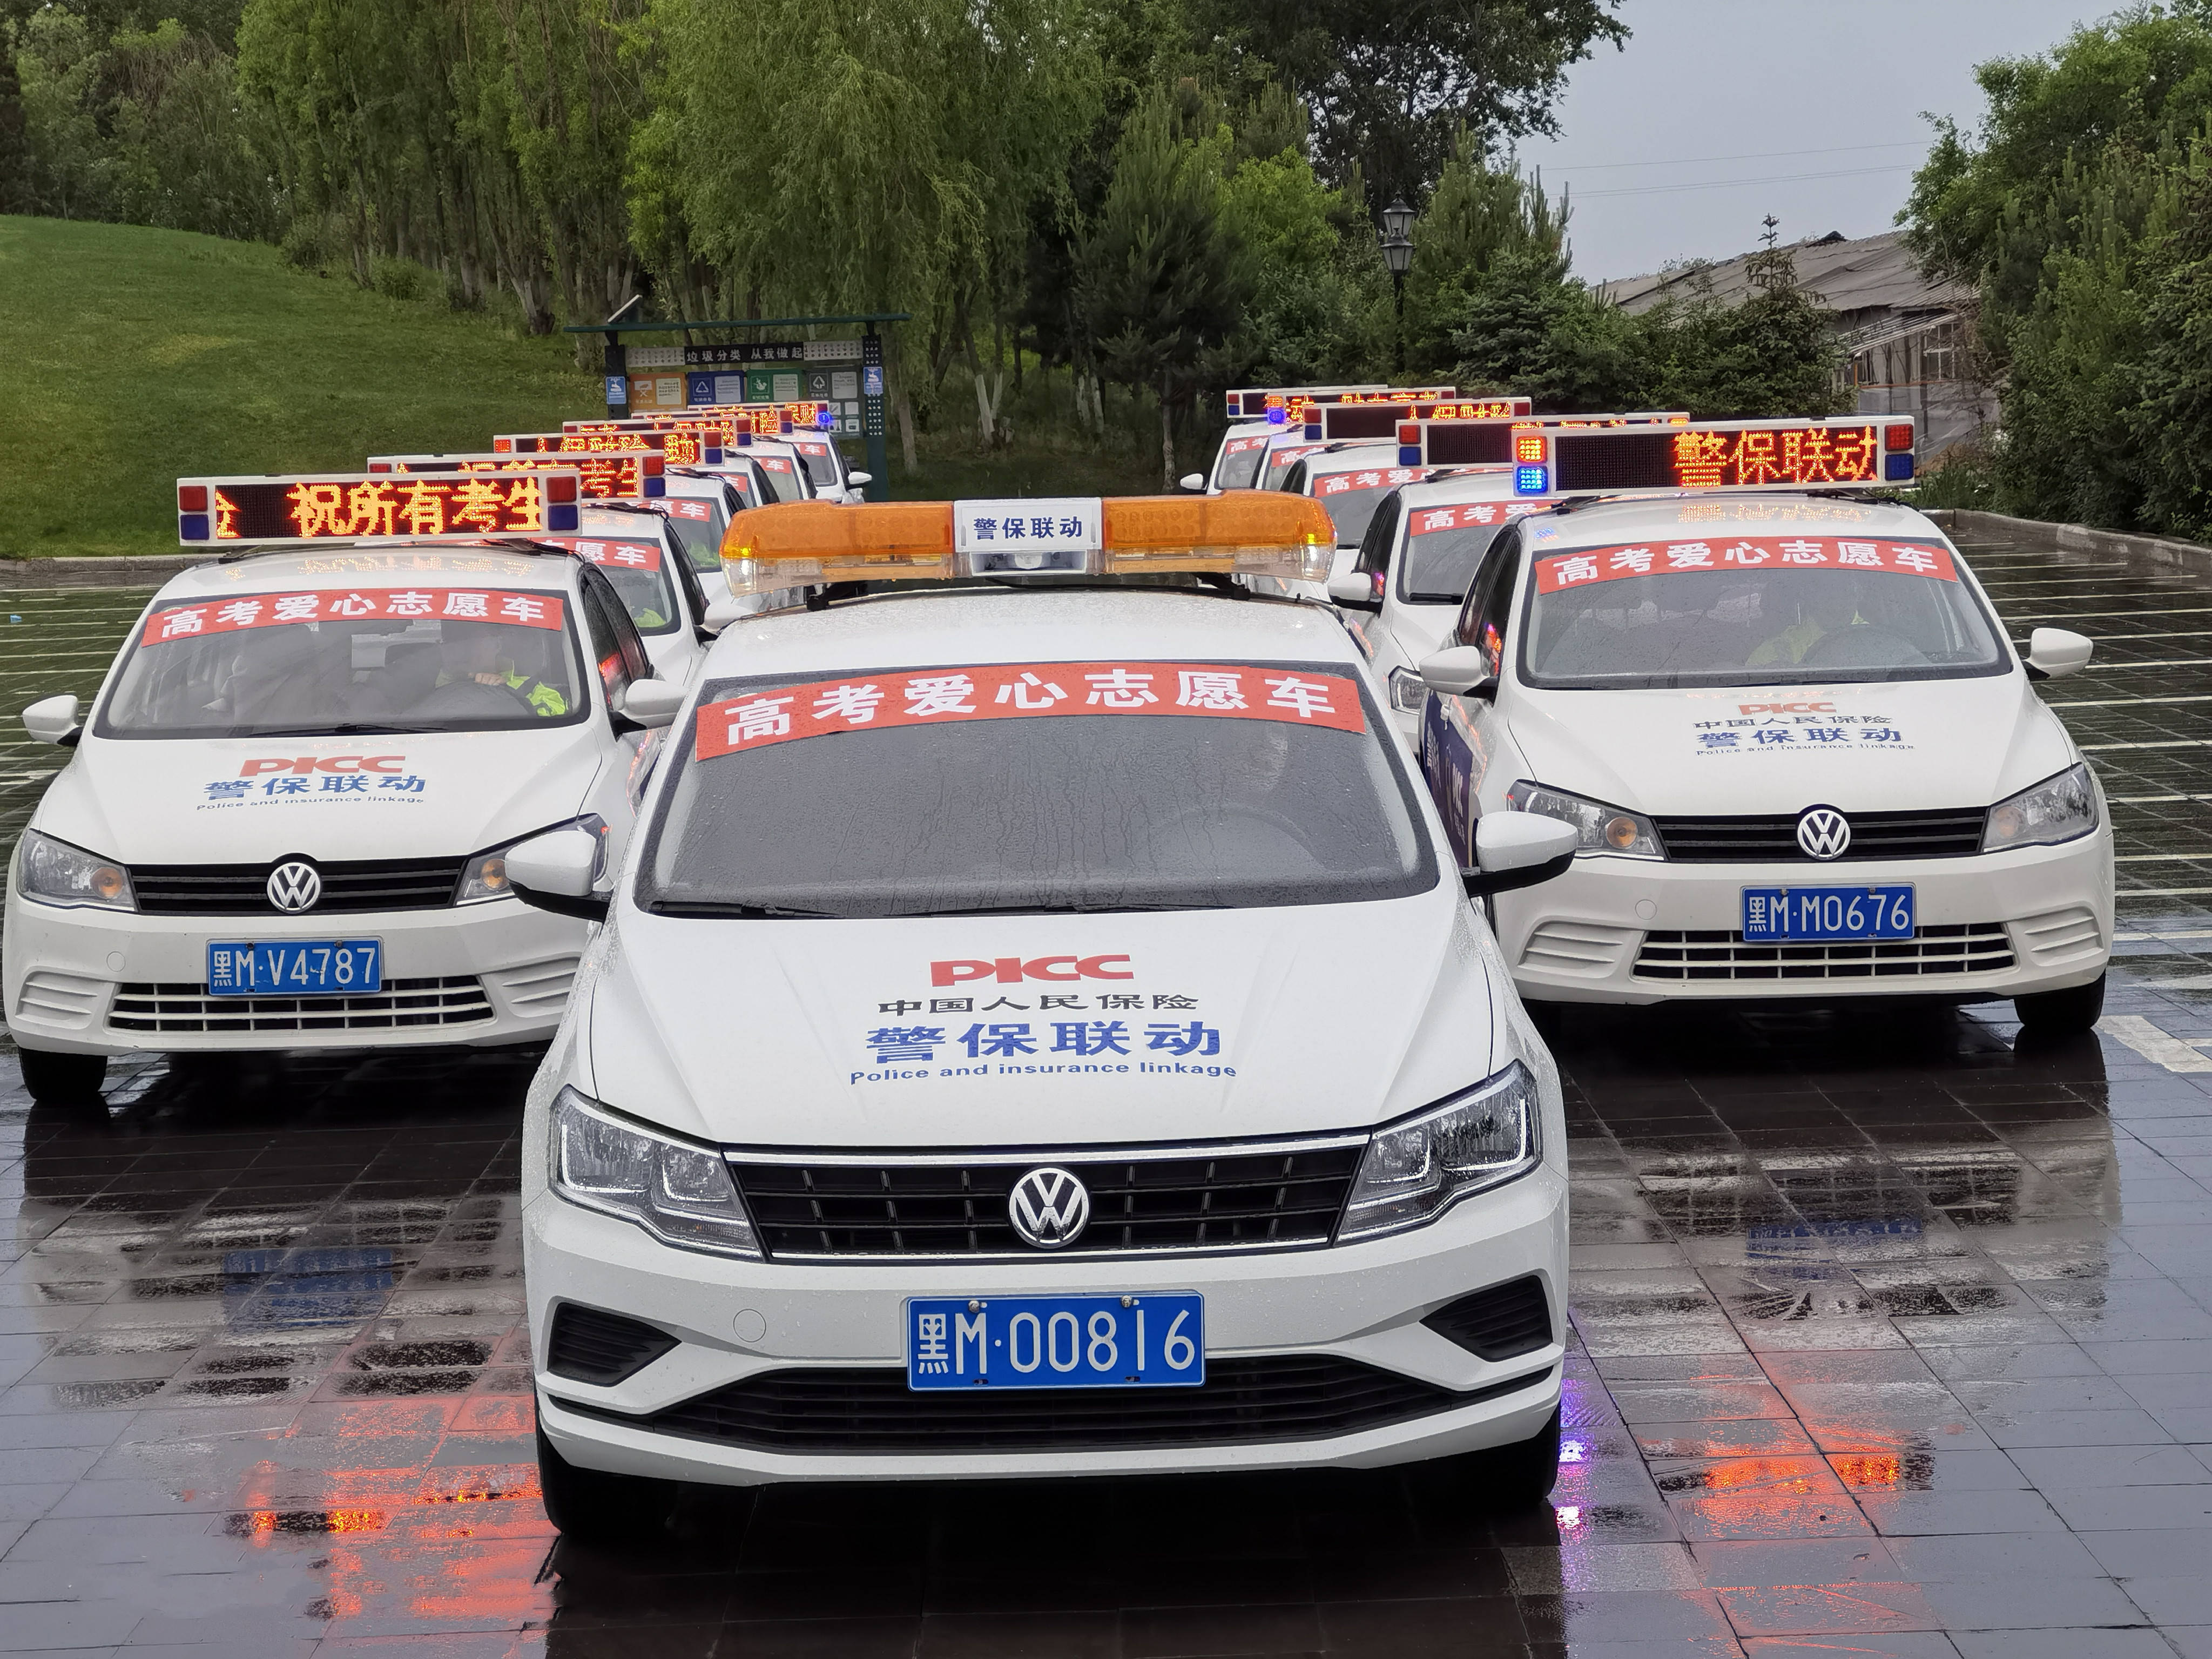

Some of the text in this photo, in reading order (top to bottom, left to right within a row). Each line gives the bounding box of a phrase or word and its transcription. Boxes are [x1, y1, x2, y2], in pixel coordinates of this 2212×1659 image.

[686, 346, 802, 362] 垃圾分类 从我做起
[1674, 425, 1878, 488] 警保联动
[286, 476, 542, 538] 祝所有考生
[973, 515, 1083, 541] 警保联动
[1554, 540, 1939, 585] 高考爱心志愿车
[161, 591, 545, 638] 高考爱心志愿车
[724, 670, 1336, 745] 高考爱心志愿车
[1738, 702, 1837, 716] PICC
[1692, 716, 1893, 730] 中国人民保险
[1696, 727, 1904, 748] 警保联动
[1696, 747, 1742, 756] Police
[239, 756, 406, 777] PICC
[203, 774, 427, 800] 警保联动
[197, 802, 244, 811] Police
[367, 795, 424, 804] linkage
[1749, 893, 1910, 932] 黑M·M0676
[213, 947, 376, 987] 黑M·V4787
[930, 954, 1135, 987] PICC
[878, 994, 1199, 1016] 中国人民保险
[865, 1021, 1221, 1064] 警保联动
[851, 1062, 1238, 1085] Police and insurance linkage
[918, 1309, 1195, 1374] 黑M·00816
